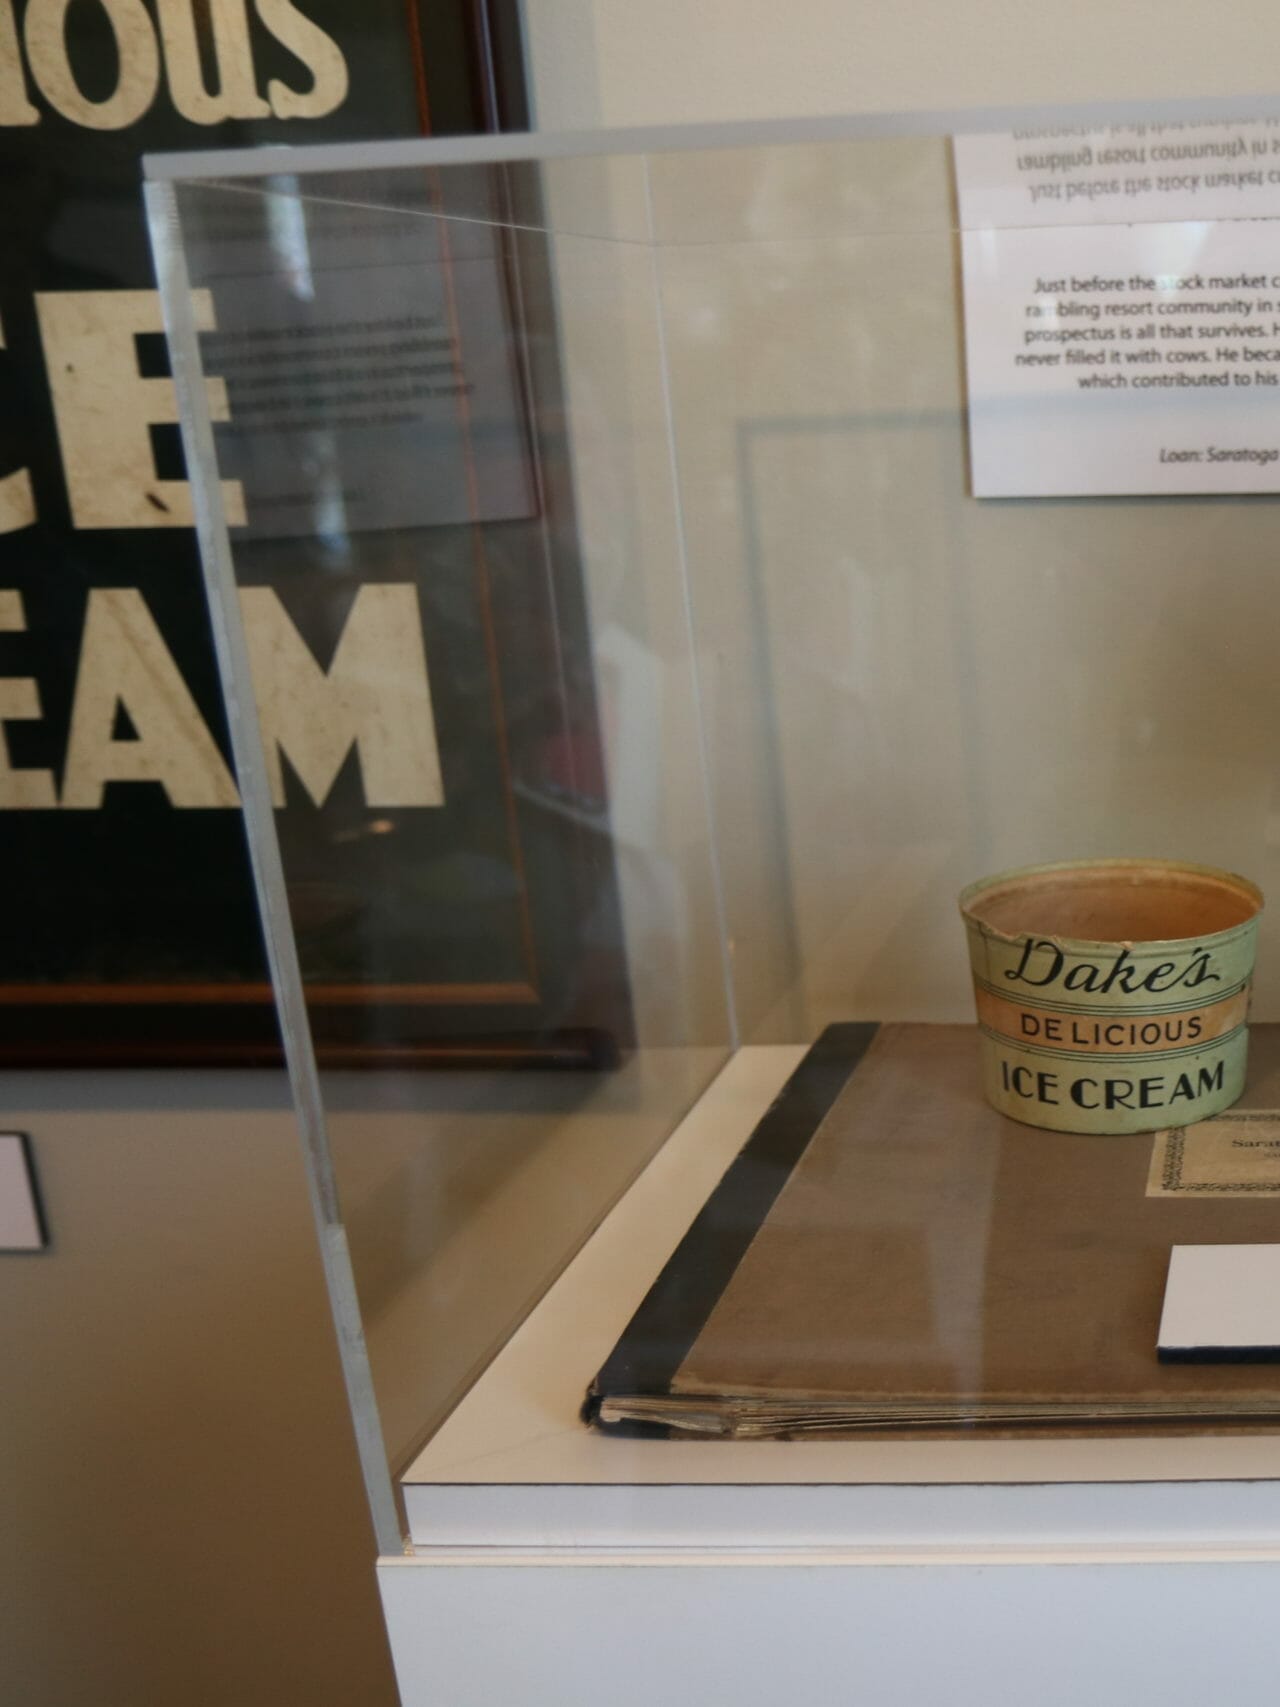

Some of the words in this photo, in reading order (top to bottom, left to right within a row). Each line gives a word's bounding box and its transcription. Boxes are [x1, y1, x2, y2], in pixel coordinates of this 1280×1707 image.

[1034, 278, 1066, 294] Just
[1072, 277, 1124, 292] before
[1129, 276, 1156, 290] the
[1209, 274, 1265, 289] market
[1026, 301, 1100, 320] rabling
[1105, 302, 1153, 316] resort
[1157, 300, 1252, 317] community
[1257, 299, 1272, 312] in
[1025, 327, 1115, 345] prospectus
[1120, 325, 1132, 340] is
[1137, 325, 1156, 339] all
[1160, 324, 1193, 338] that
[1198, 324, 1268, 338] survives.
[1015, 353, 1060, 366] never
[1065, 348, 1105, 365] filled
[1110, 348, 1122, 364] it
[1126, 348, 1160, 363] with
[1166, 350, 1211, 363] cows.
[1215, 347, 1237, 362] He
[1078, 374, 1128, 389] which
[1132, 372, 1229, 388] contributed
[1233, 373, 1251, 386] to
[1255, 371, 1278, 386] his
[1160, 448, 1201, 464] Loan:
[1206, 447, 1279, 465] Saratoga
[1004, 938, 1220, 996] Dake's
[1020, 1013, 1203, 1047] DELICIOUS
[1001, 1060, 1059, 1104] ICE
[1070, 1060, 1225, 1112] CREAM
